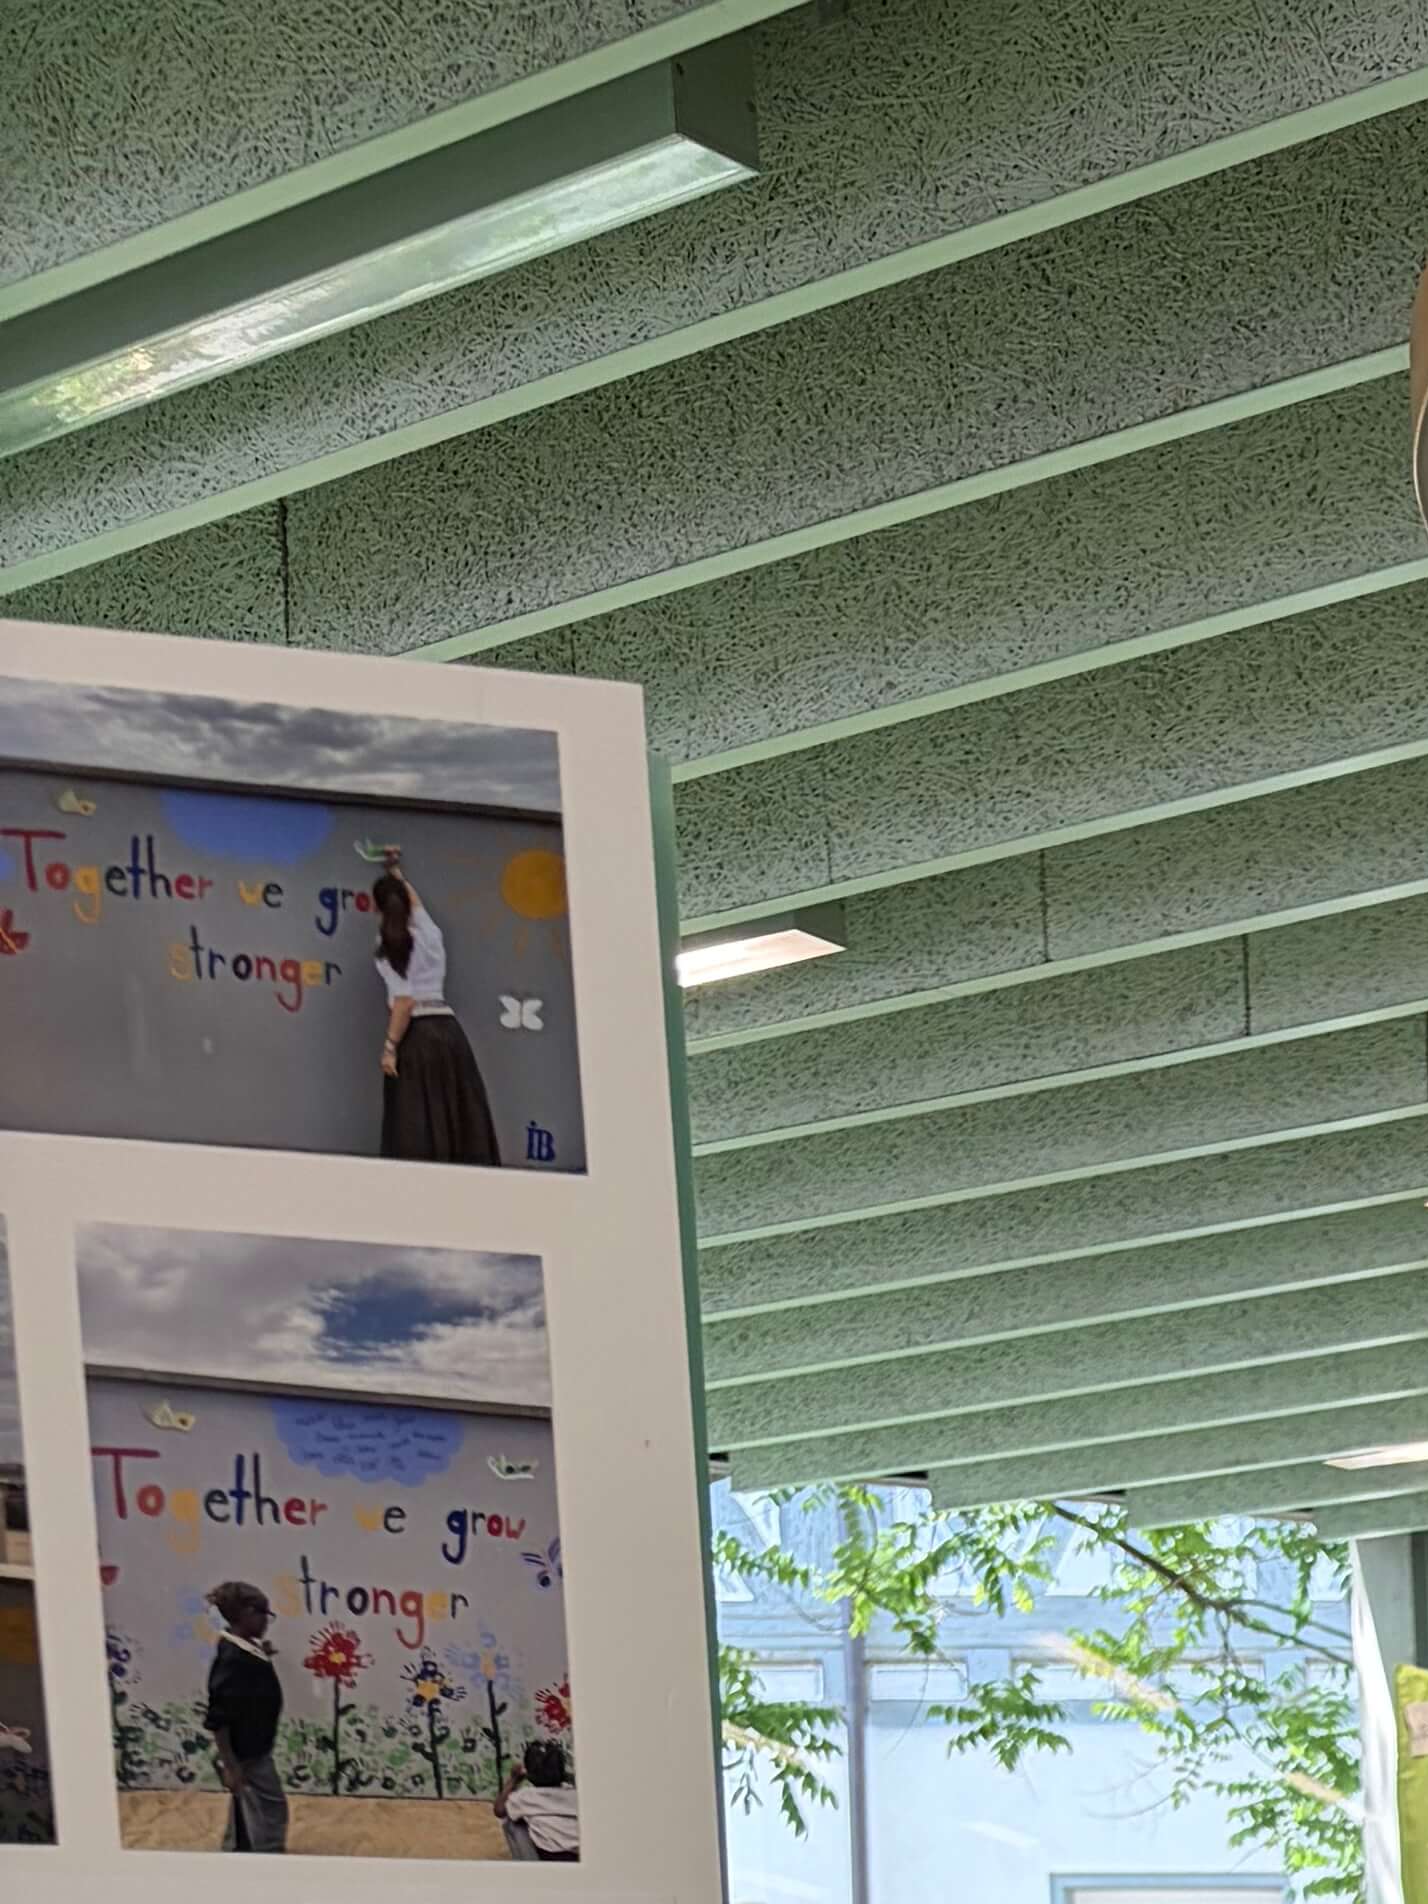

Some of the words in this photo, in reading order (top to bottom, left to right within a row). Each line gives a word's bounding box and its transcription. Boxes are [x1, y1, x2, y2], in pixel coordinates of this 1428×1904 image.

[2, 828, 213, 926] Together
[314, 890, 380, 937] gro
[168, 925, 343, 1013] stronger
[91, 1447, 329, 1555] Together
[442, 1505, 527, 1566] grow
[272, 1555, 470, 1650] stronger
